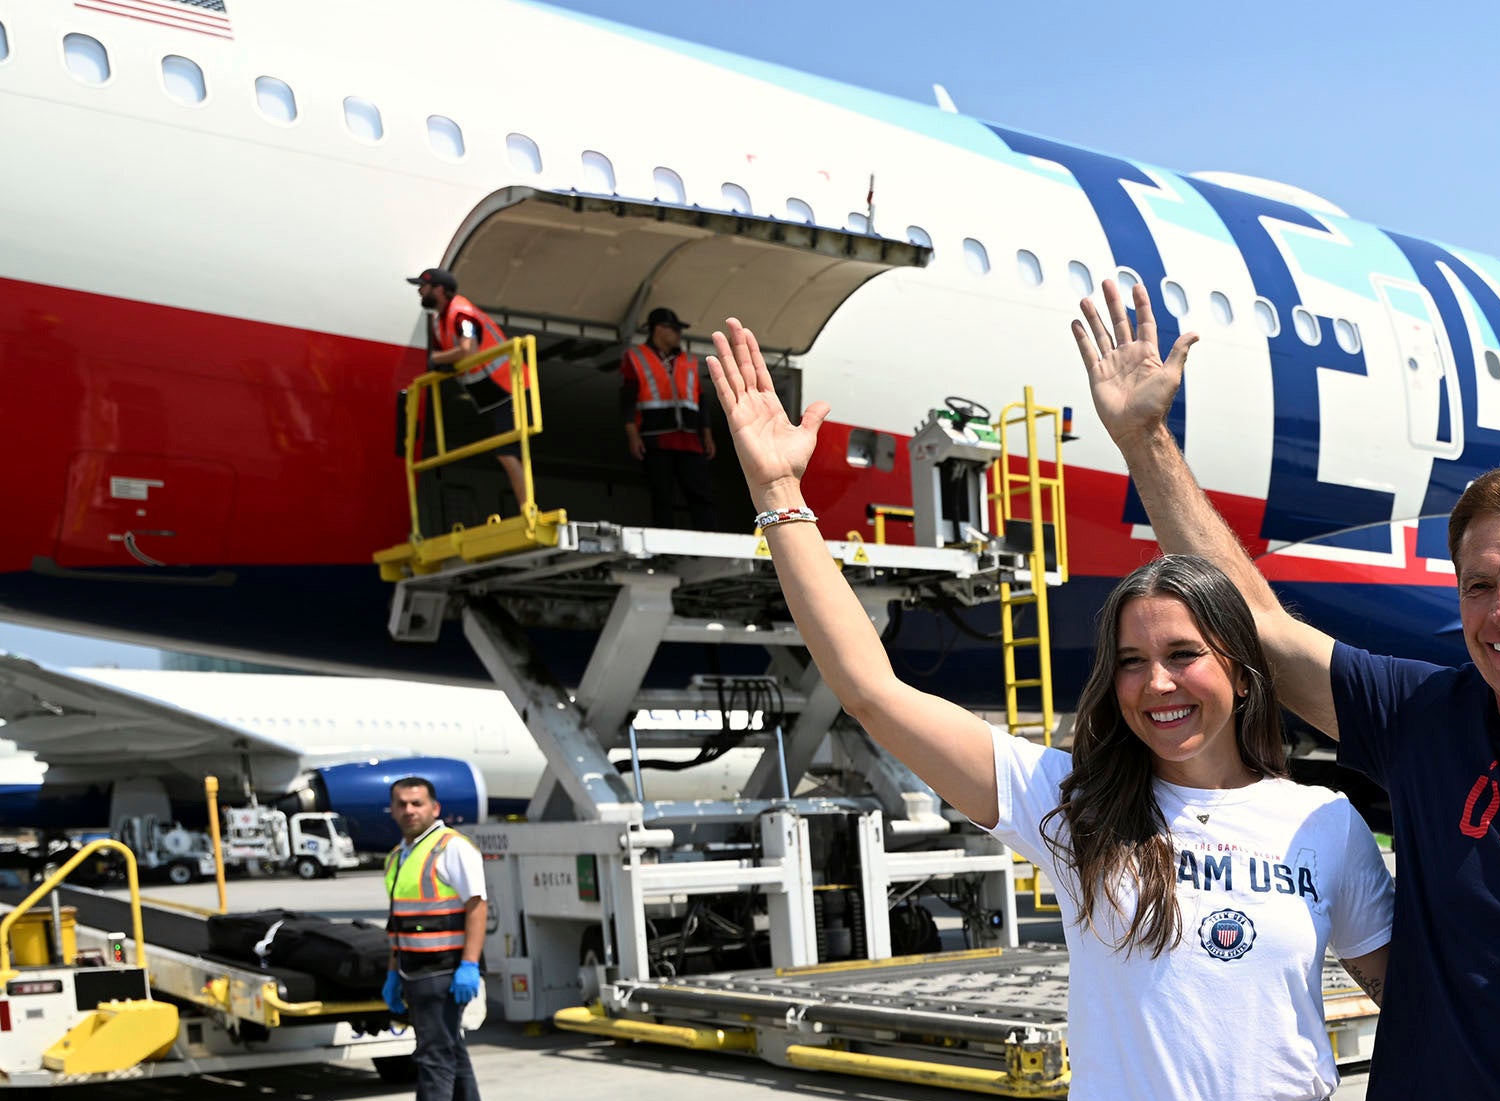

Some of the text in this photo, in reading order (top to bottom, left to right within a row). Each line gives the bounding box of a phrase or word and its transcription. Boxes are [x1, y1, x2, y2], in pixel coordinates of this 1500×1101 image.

[541, 872, 572, 887] DELTA
[1176, 849, 1319, 903] AM USA
